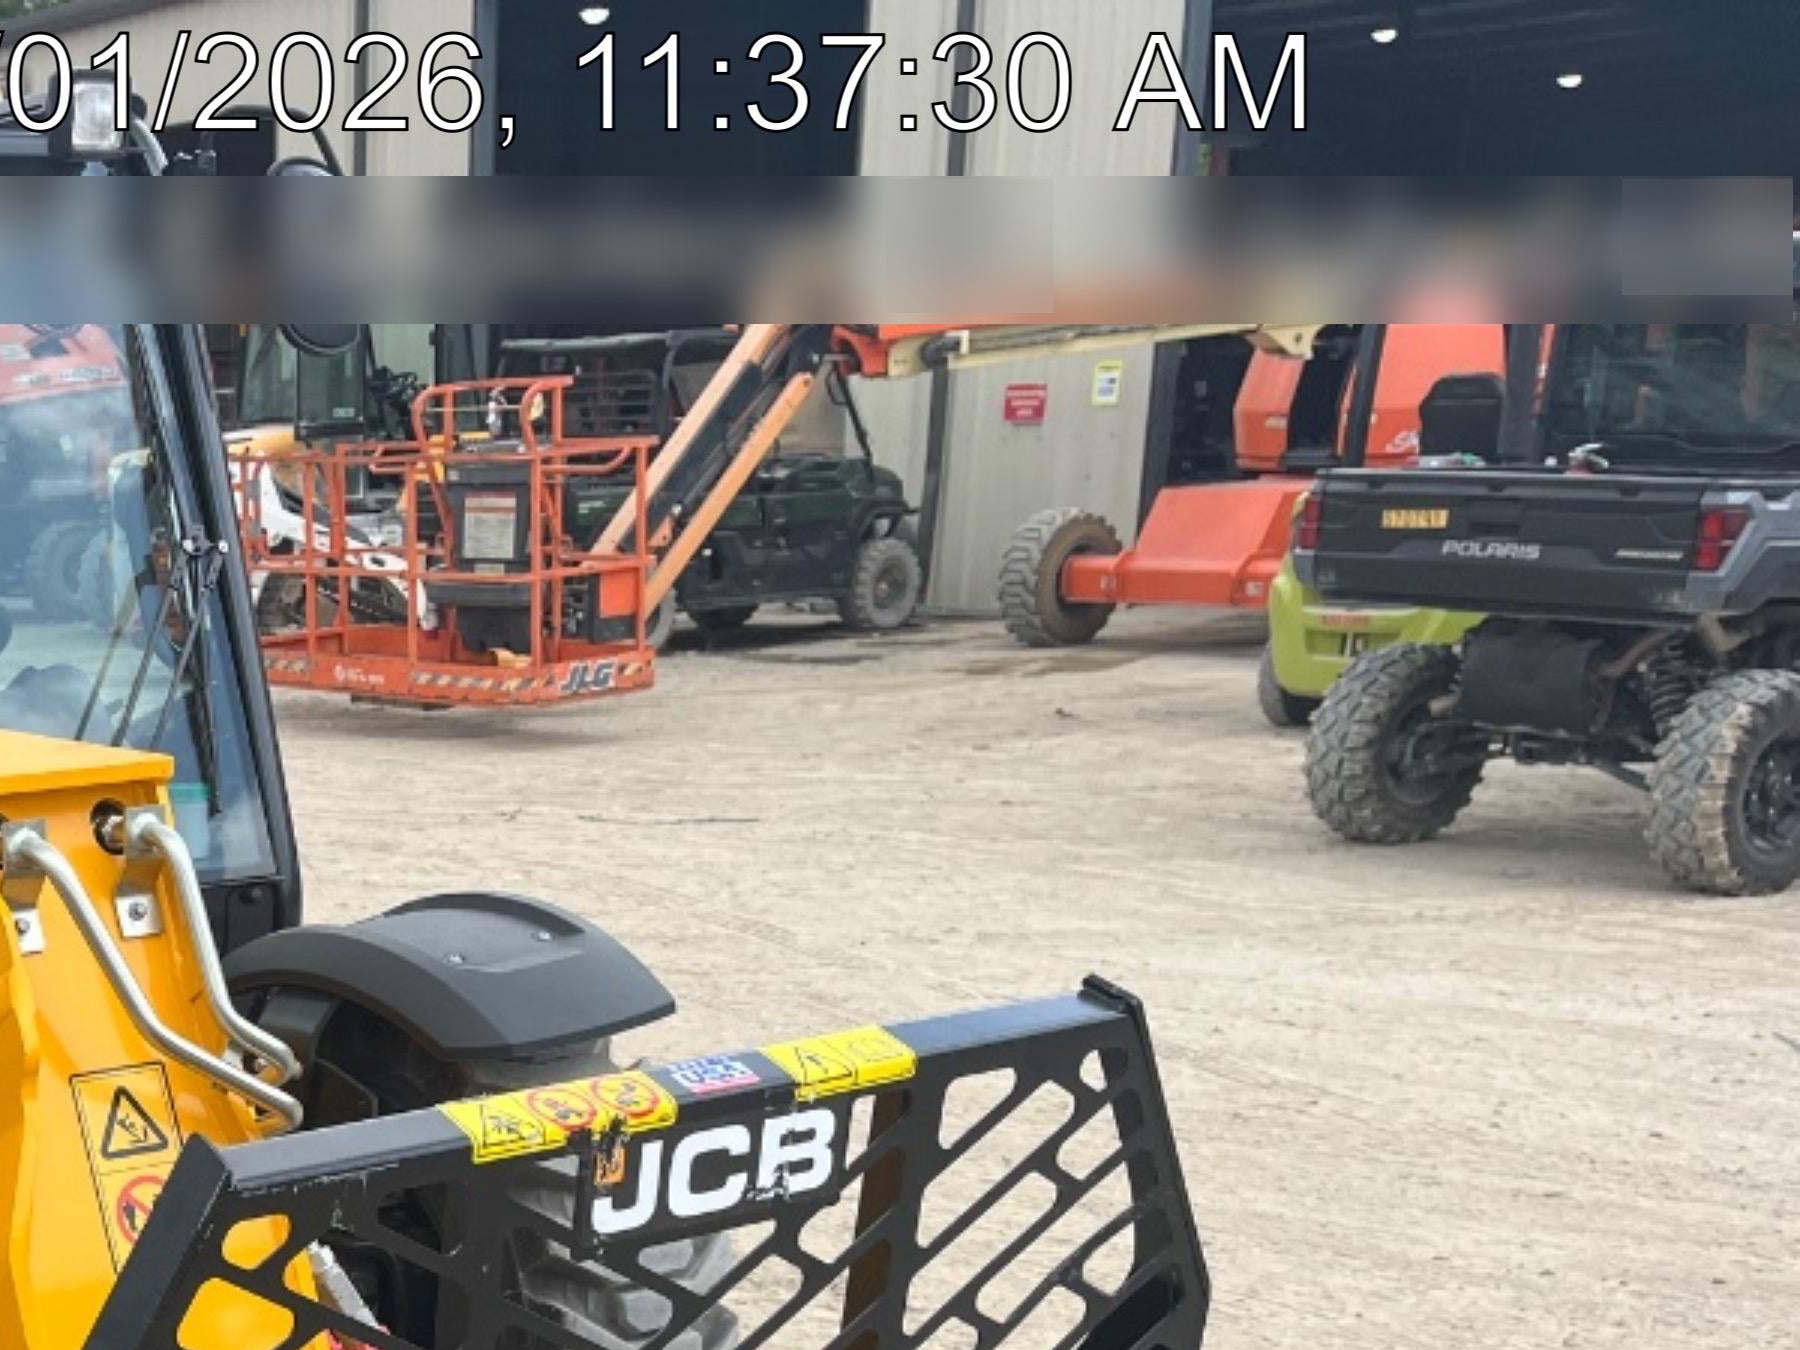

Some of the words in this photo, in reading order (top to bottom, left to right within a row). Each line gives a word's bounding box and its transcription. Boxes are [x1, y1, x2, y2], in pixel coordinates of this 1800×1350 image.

[1441, 539, 1543, 560] POLARIS
[560, 660, 614, 693] JLG
[591, 1108, 836, 1234] JCB
